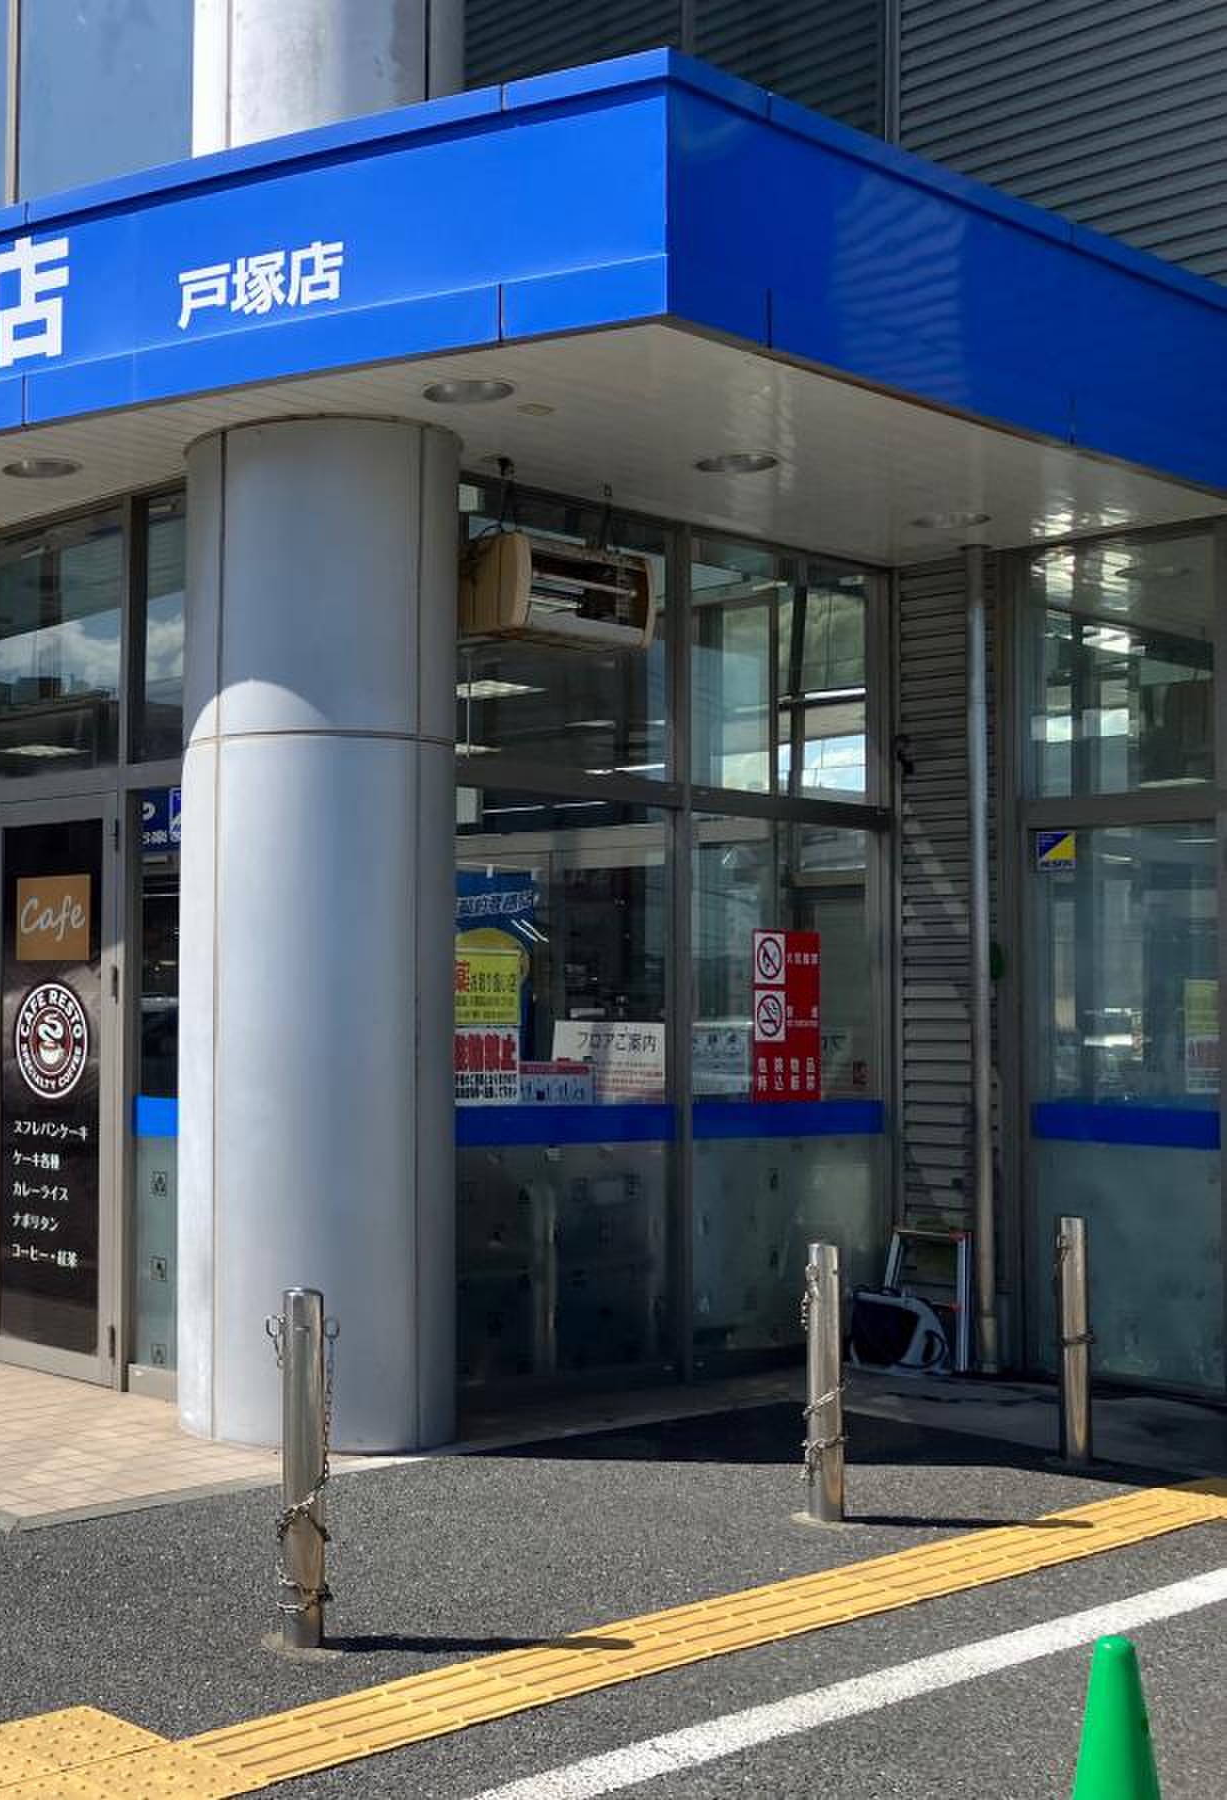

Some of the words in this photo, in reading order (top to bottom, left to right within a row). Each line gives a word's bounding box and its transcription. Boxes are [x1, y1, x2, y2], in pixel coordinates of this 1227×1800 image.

[177, 240, 344, 329] 戸塚店
[20, 895, 86, 942] Cafe
[21, 991, 47, 1037] CAFE
[49, 990, 83, 1039] RESTO
[577, 1029, 657, 1053] フロアご案内
[13, 1120, 88, 1142] スフレパンケーキ
[12, 1149, 61, 1170] ケーキ各種
[12, 1180, 69, 1201] カレーライス
[12, 1212, 59, 1232] ナポリタン
